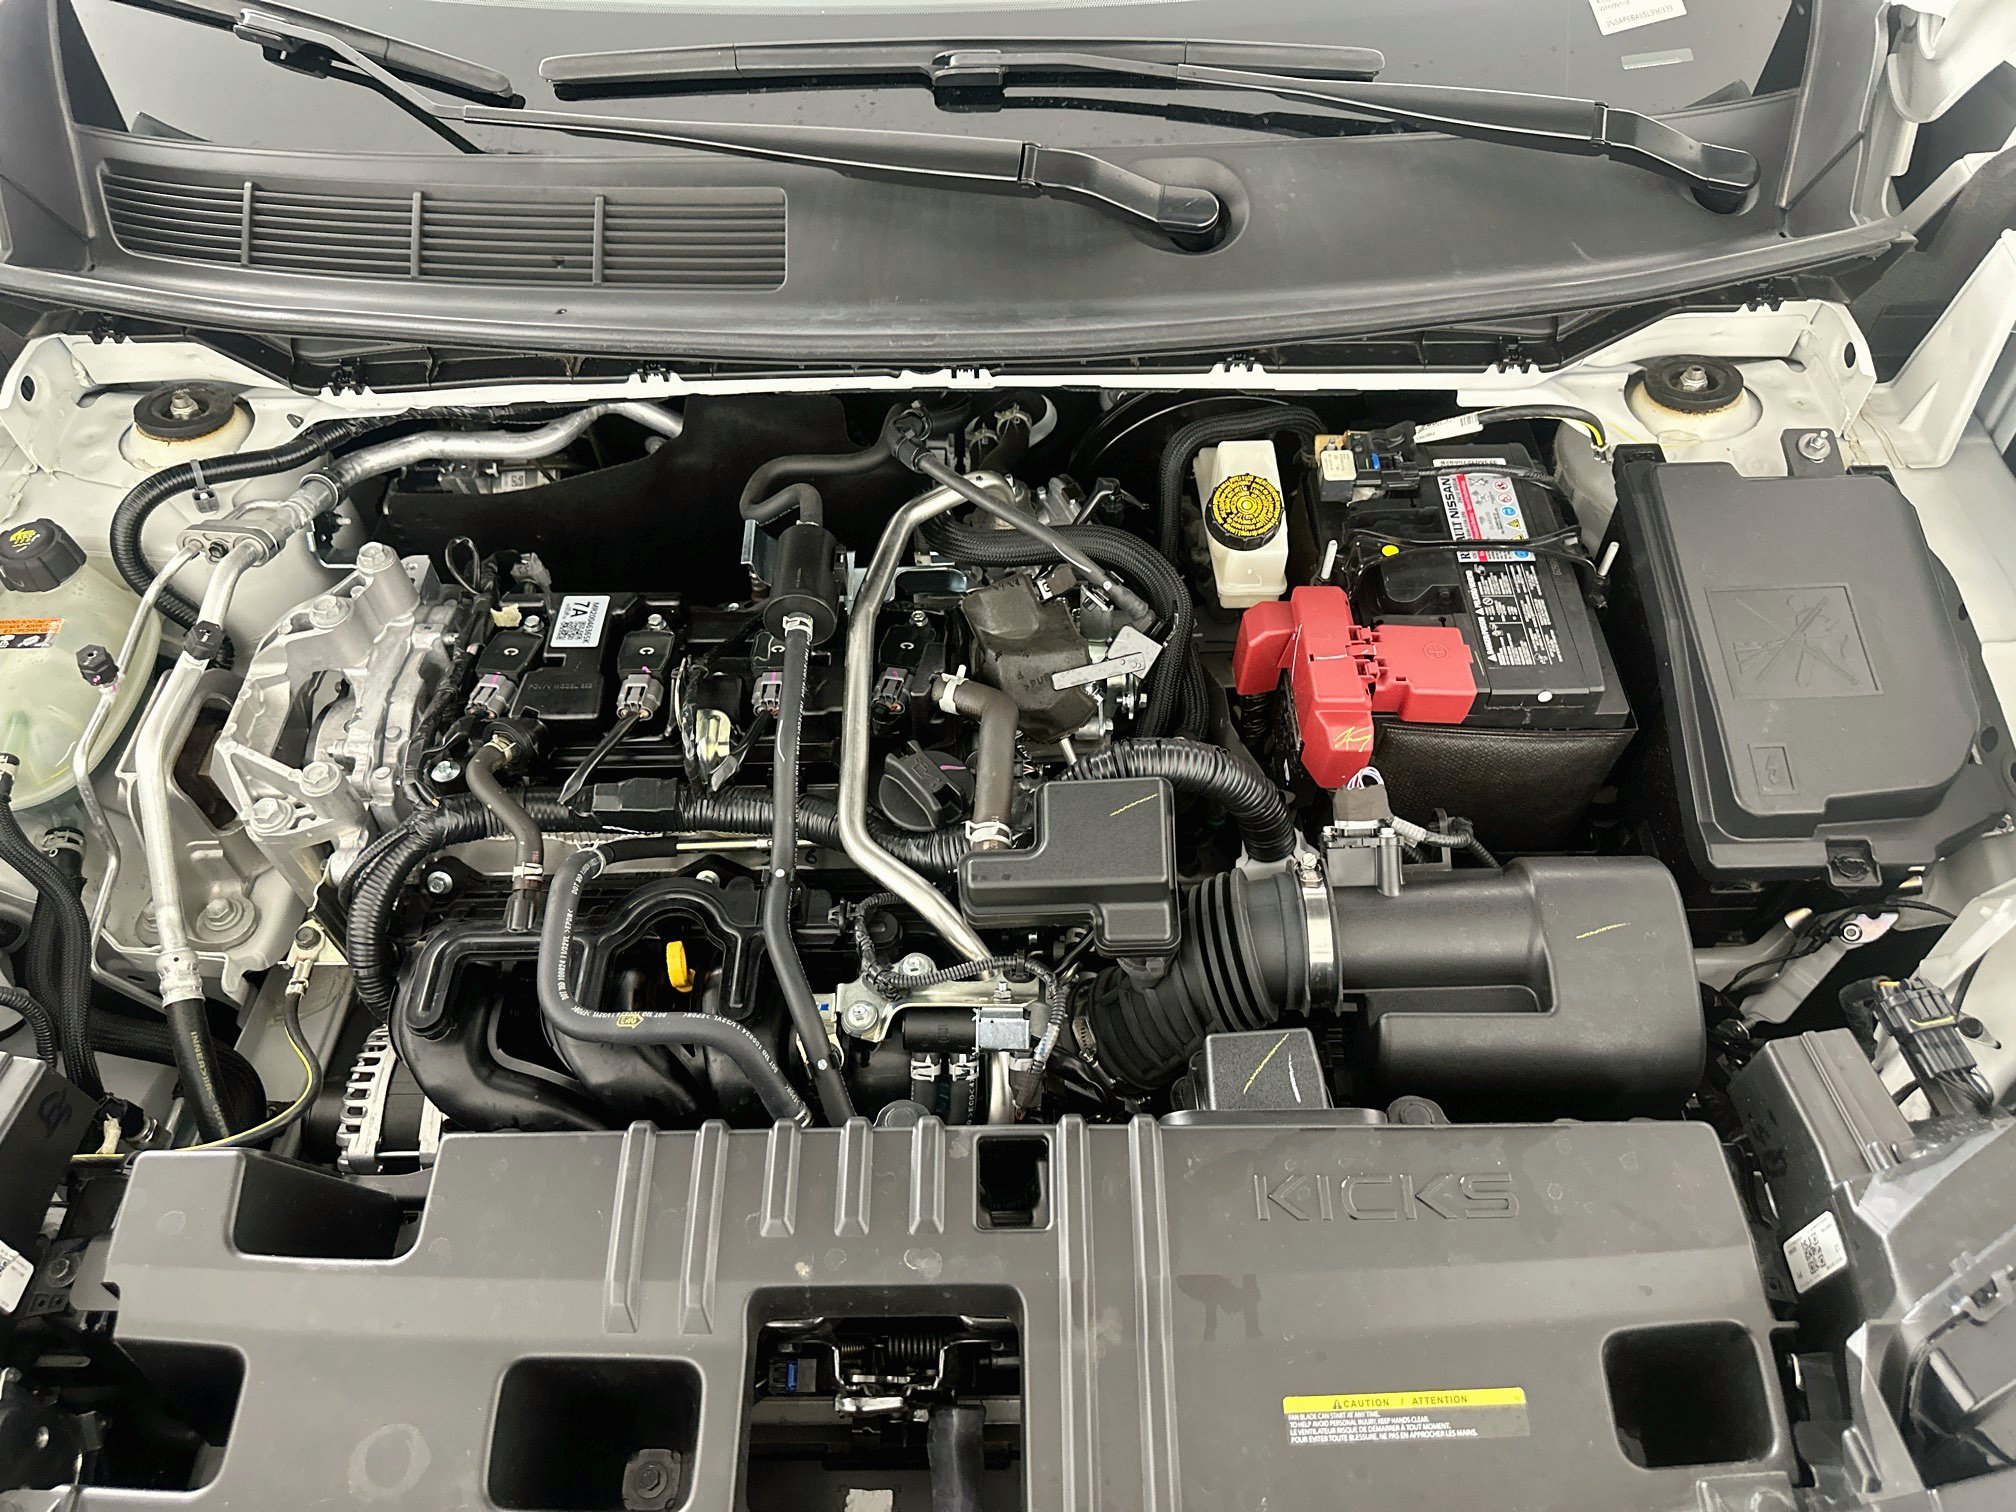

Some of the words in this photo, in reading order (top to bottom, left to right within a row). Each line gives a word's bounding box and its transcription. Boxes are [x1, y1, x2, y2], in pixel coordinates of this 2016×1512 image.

[1440, 478, 1460, 519] NISSAN
[1451, 521, 1471, 560] RAULT
[571, 602, 591, 618] 7A
[741, 1028, 763, 1050] 100824
[1254, 1173, 1519, 1222] KICKS
[1343, 1399, 1390, 1408] CAUTION
[1412, 1395, 1468, 1405] ATTENTION
[1298, 1420, 1312, 1428] HELP
[1330, 1418, 1357, 1426] PERSONAL
[1391, 1416, 1411, 1424] HANDS
[1298, 1427, 1336, 1436] VENTILATEUR
[1336, 1426, 1358, 1434] RISQUE
[1406, 1422, 1423, 1430] TOUT
[1291, 1436, 1308, 1444] POUR
[1329, 1434, 1348, 1442] TOUTE
[1388, 1431, 1400, 1439] PAS
[1409, 1430, 1445, 1438] APPROCHER
[1445, 1429, 1456, 1437] LES
